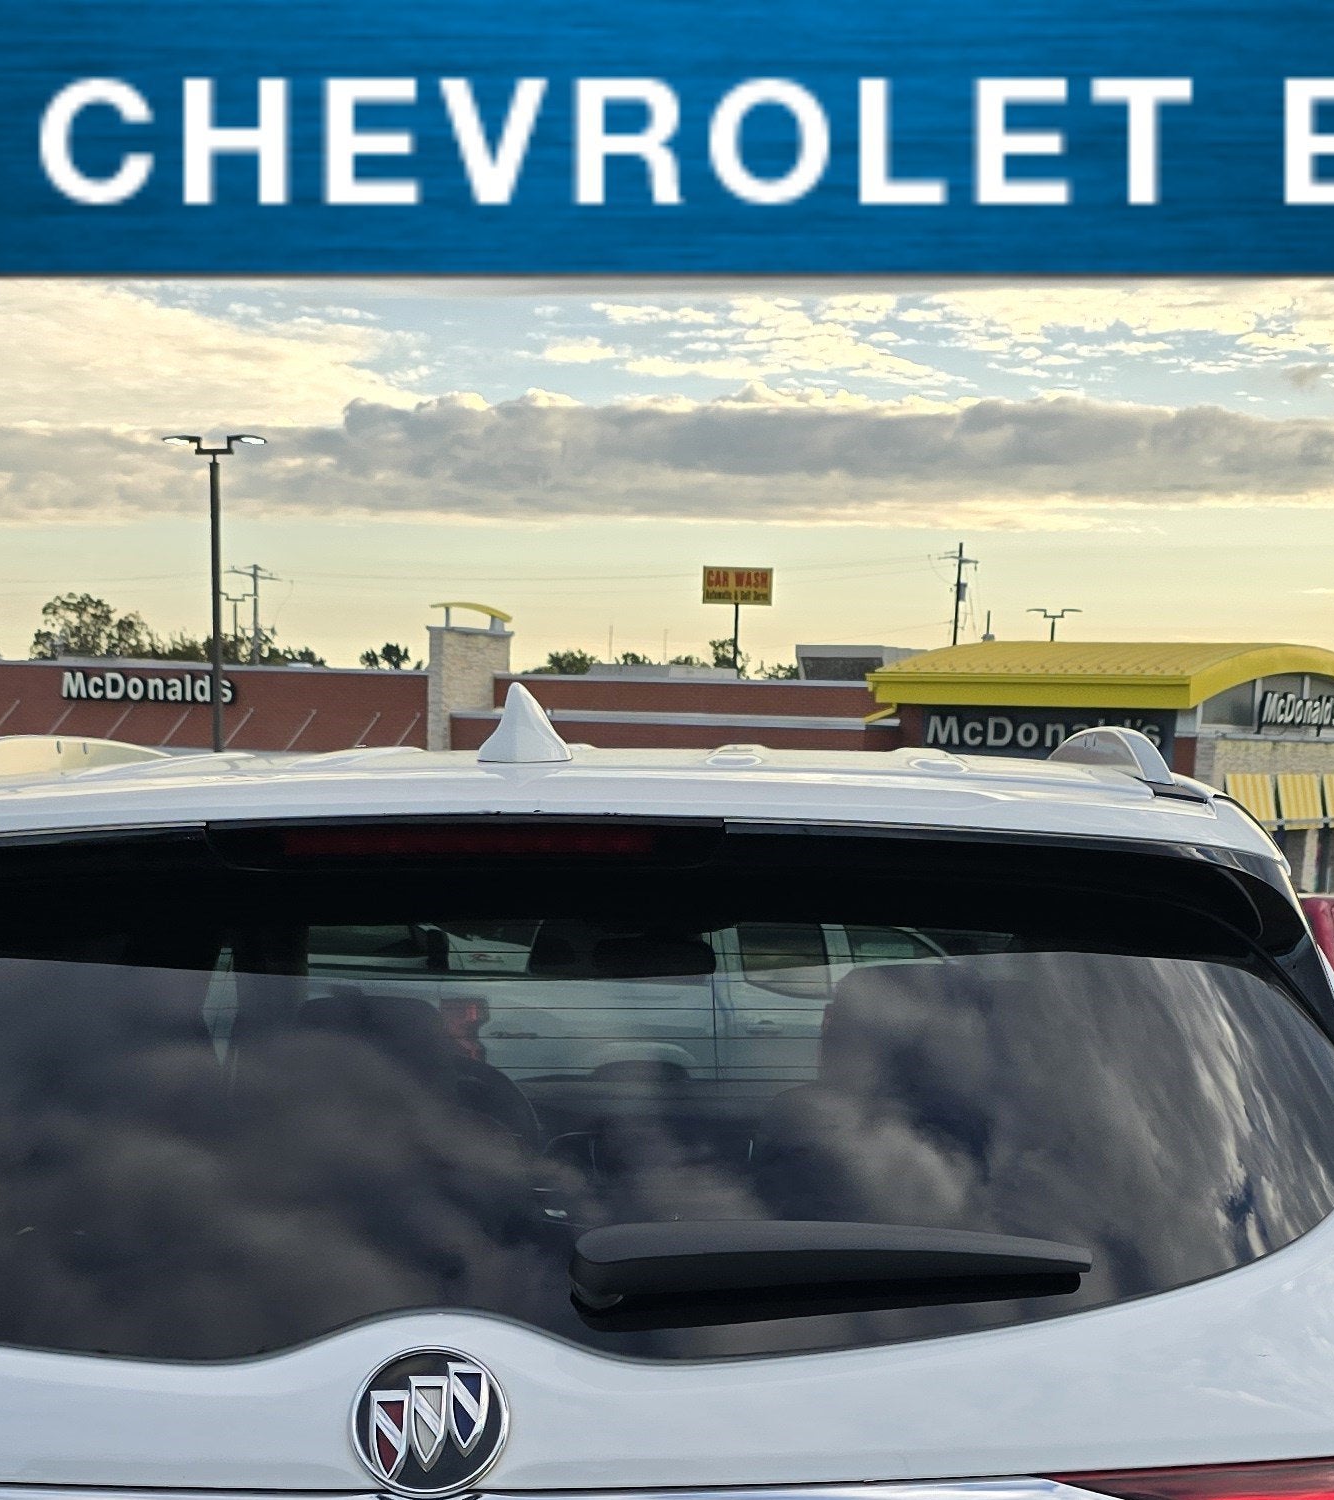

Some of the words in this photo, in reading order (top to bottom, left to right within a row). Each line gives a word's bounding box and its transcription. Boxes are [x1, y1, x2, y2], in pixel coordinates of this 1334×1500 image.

[707, 570, 730, 588] CAR
[734, 571, 769, 589] WASH
[62, 671, 234, 703] McDonalds
